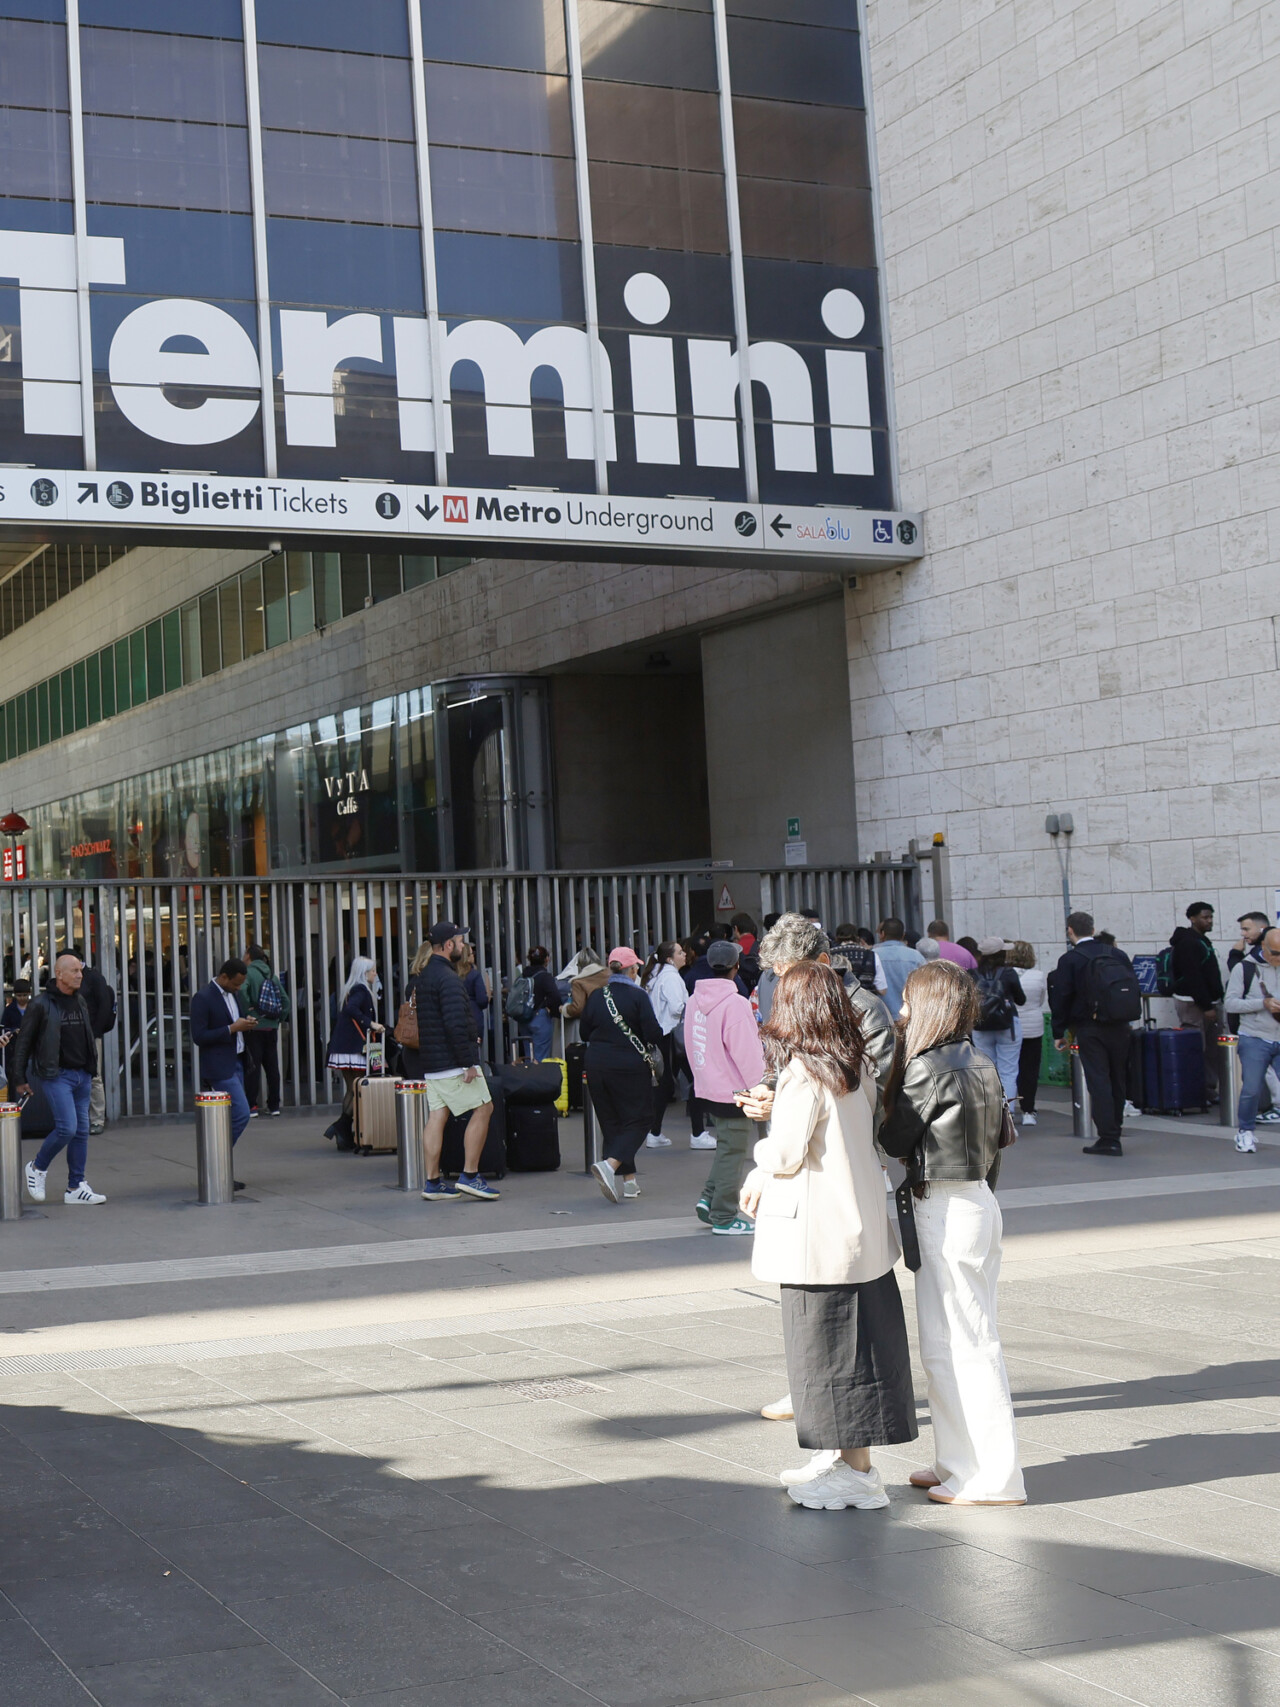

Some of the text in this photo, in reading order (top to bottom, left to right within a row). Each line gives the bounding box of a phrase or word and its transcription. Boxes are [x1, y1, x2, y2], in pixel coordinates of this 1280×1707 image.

[141, 481, 349, 514] Biglietti Tickets
[475, 496, 562, 524] Metro
[567, 501, 715, 535] Underground
